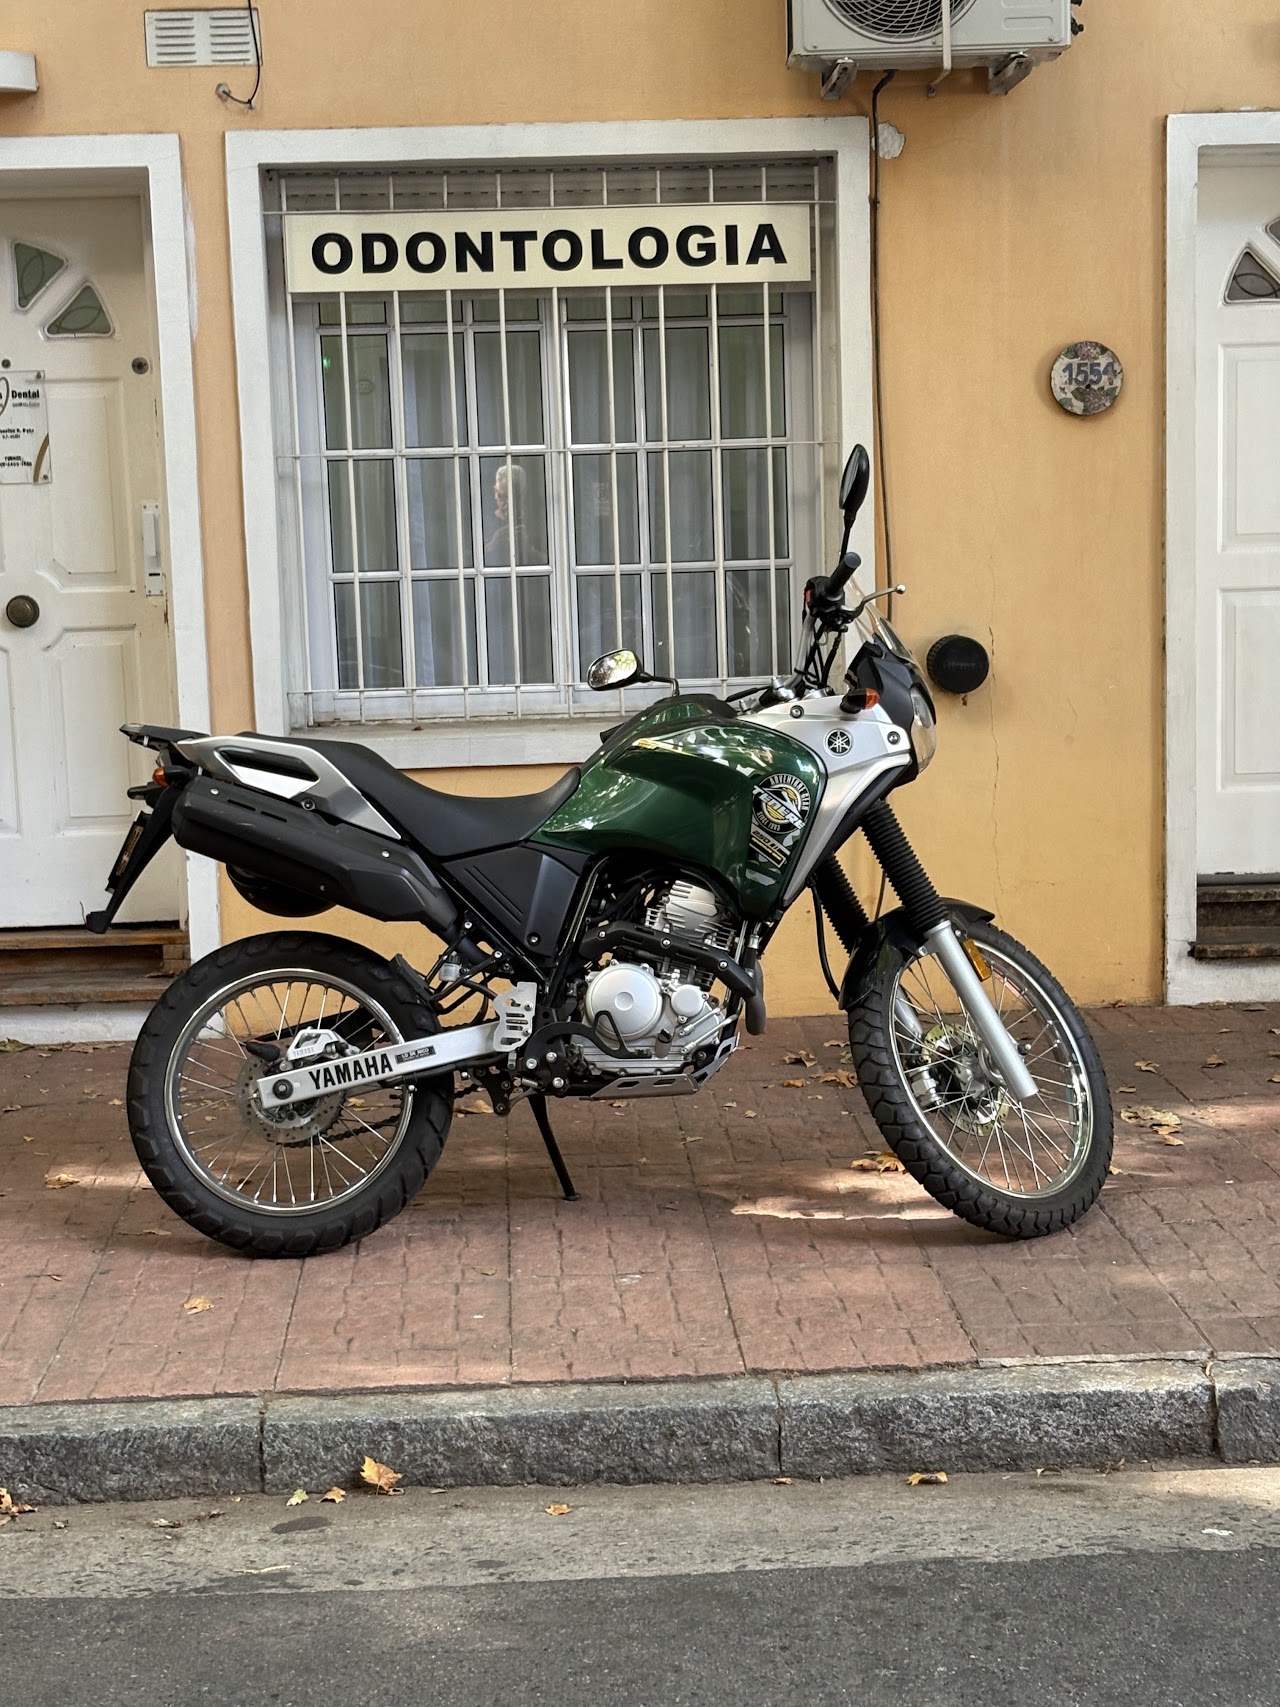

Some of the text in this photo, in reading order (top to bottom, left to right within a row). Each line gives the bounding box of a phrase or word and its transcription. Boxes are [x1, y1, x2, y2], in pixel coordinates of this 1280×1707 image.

[311, 223, 788, 274] ODONTOLOGIA
[1062, 361, 1117, 386] 1554
[11, 389, 40, 399] Dental
[769, 774, 805, 793] ADVENTURE
[752, 785, 806, 829] TENERE
[308, 1053, 393, 1090] YAMAHA
